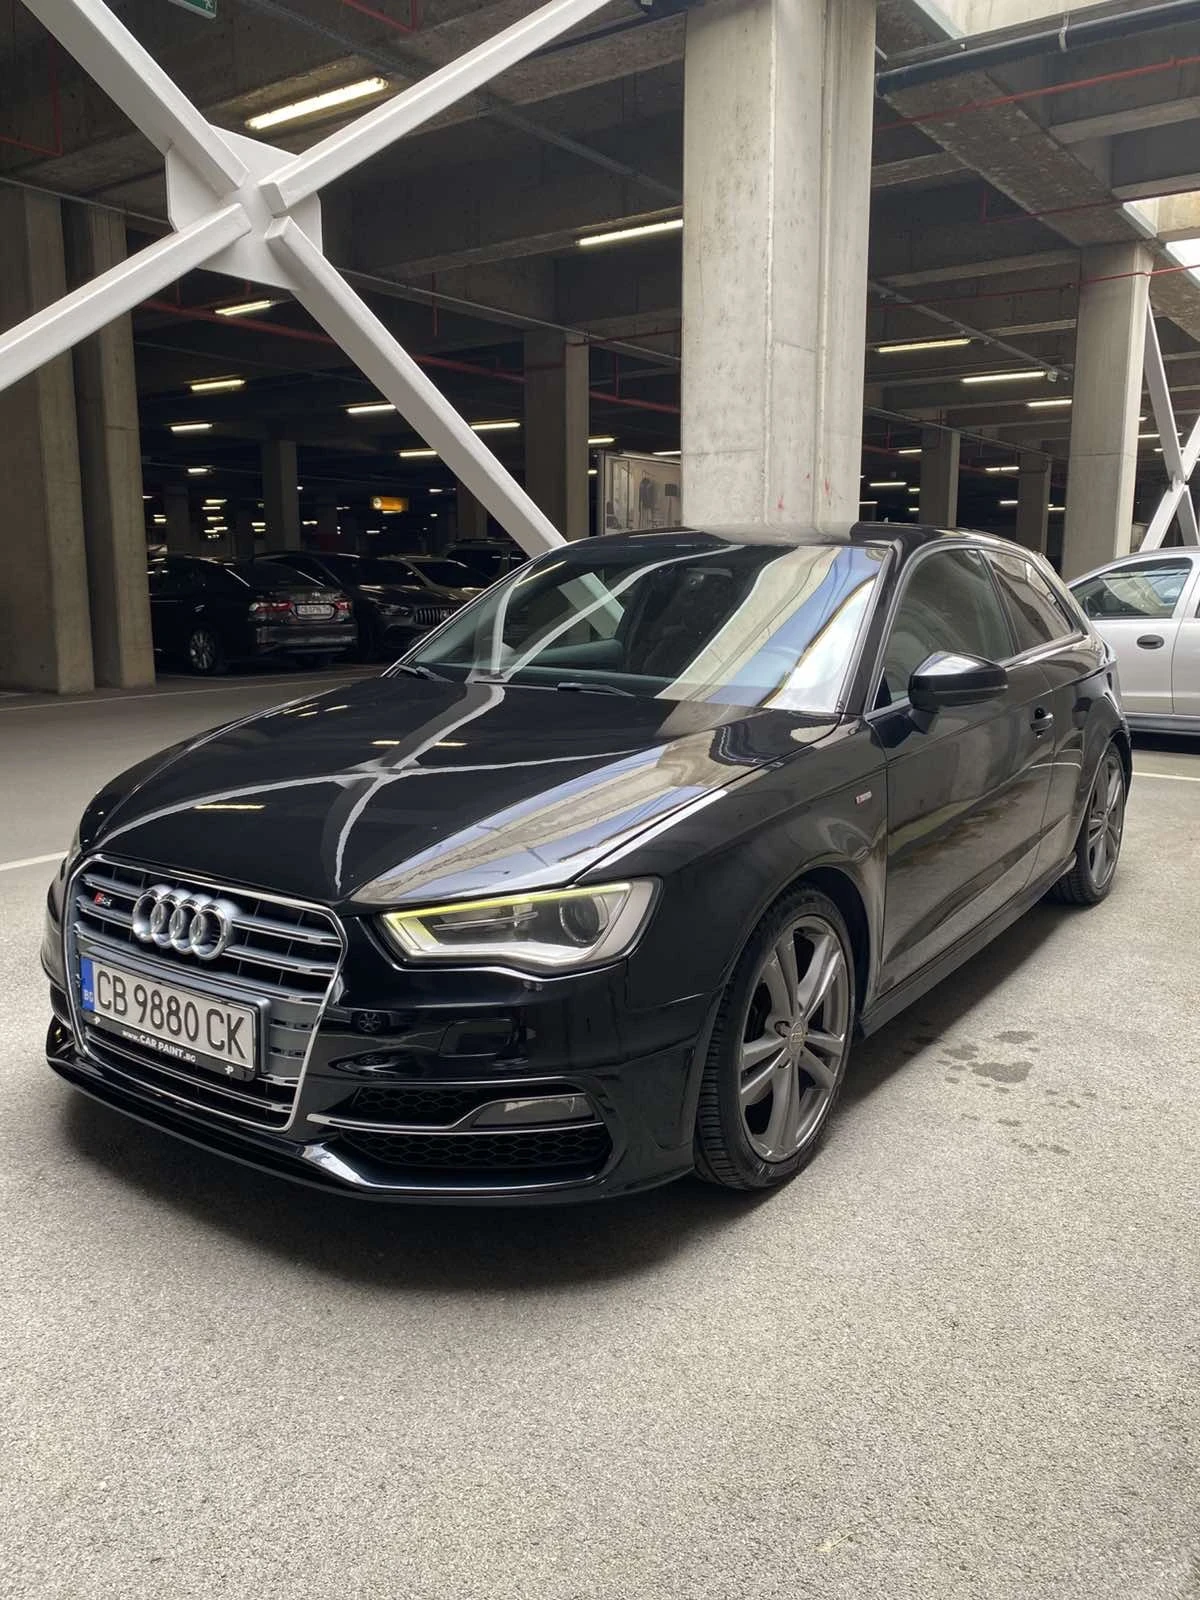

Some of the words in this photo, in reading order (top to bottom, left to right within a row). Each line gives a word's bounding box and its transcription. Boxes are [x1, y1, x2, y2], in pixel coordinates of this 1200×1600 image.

[97, 970, 128, 1016] CB
[134, 983, 200, 1042] 9880
[206, 1008, 247, 1060] CK
